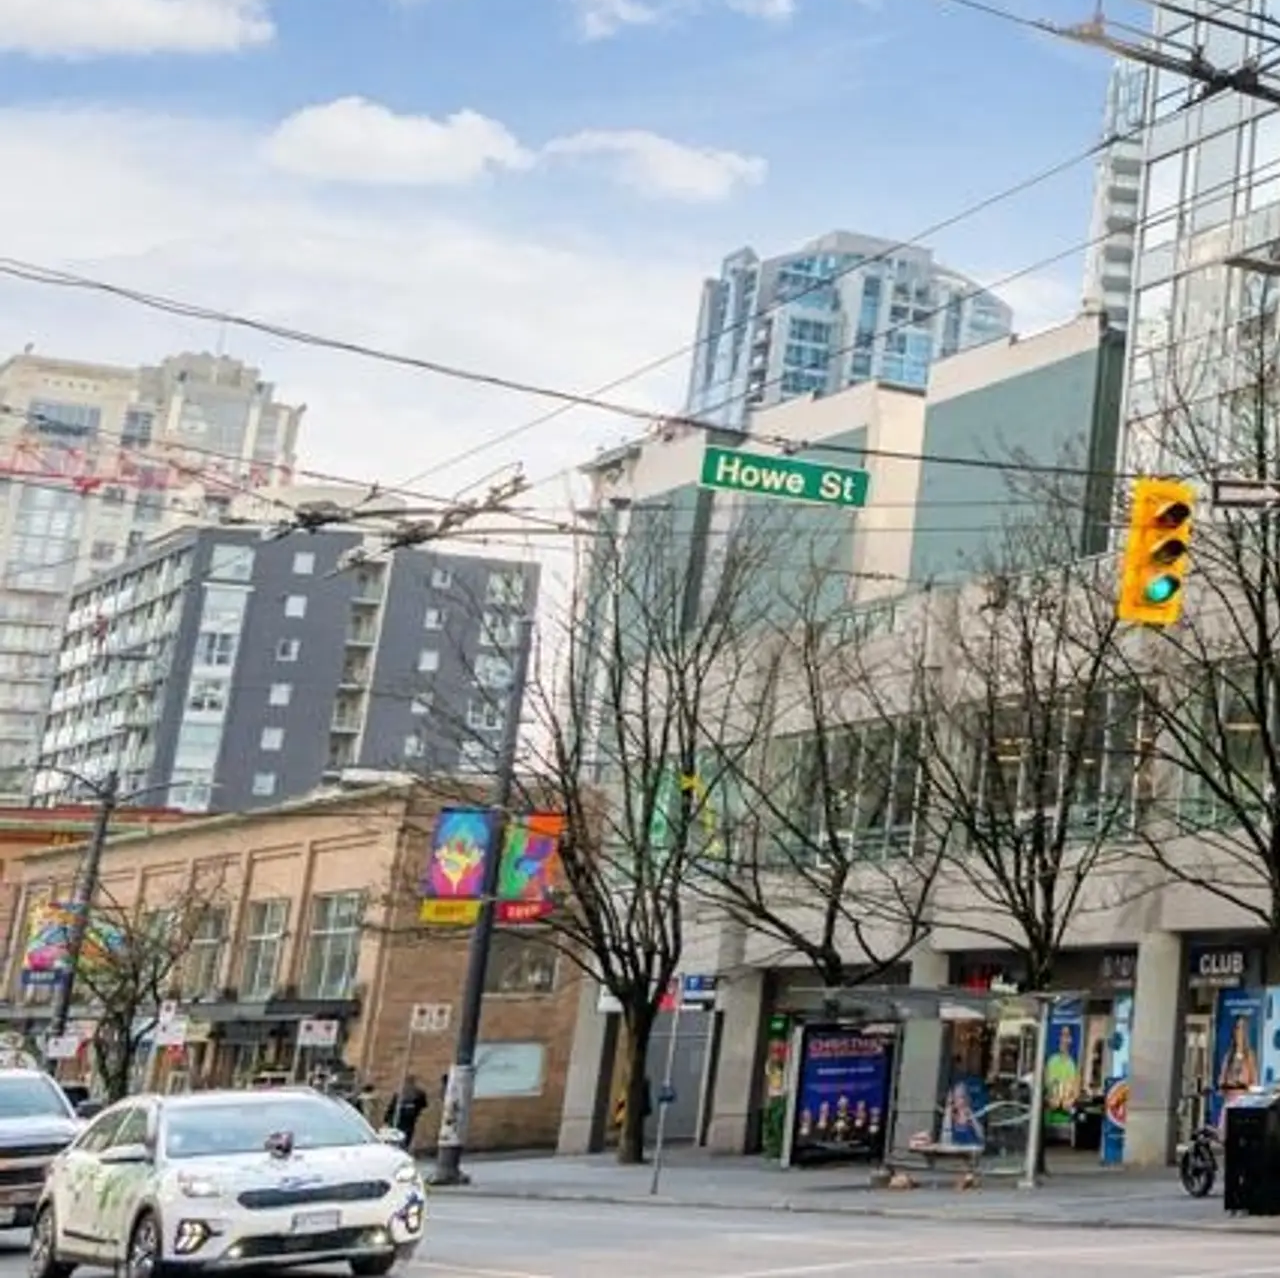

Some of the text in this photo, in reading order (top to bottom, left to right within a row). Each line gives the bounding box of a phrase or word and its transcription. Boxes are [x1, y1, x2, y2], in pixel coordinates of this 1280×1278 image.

[716, 454, 856, 503] Howe St
[1199, 952, 1245, 974] CLUB
